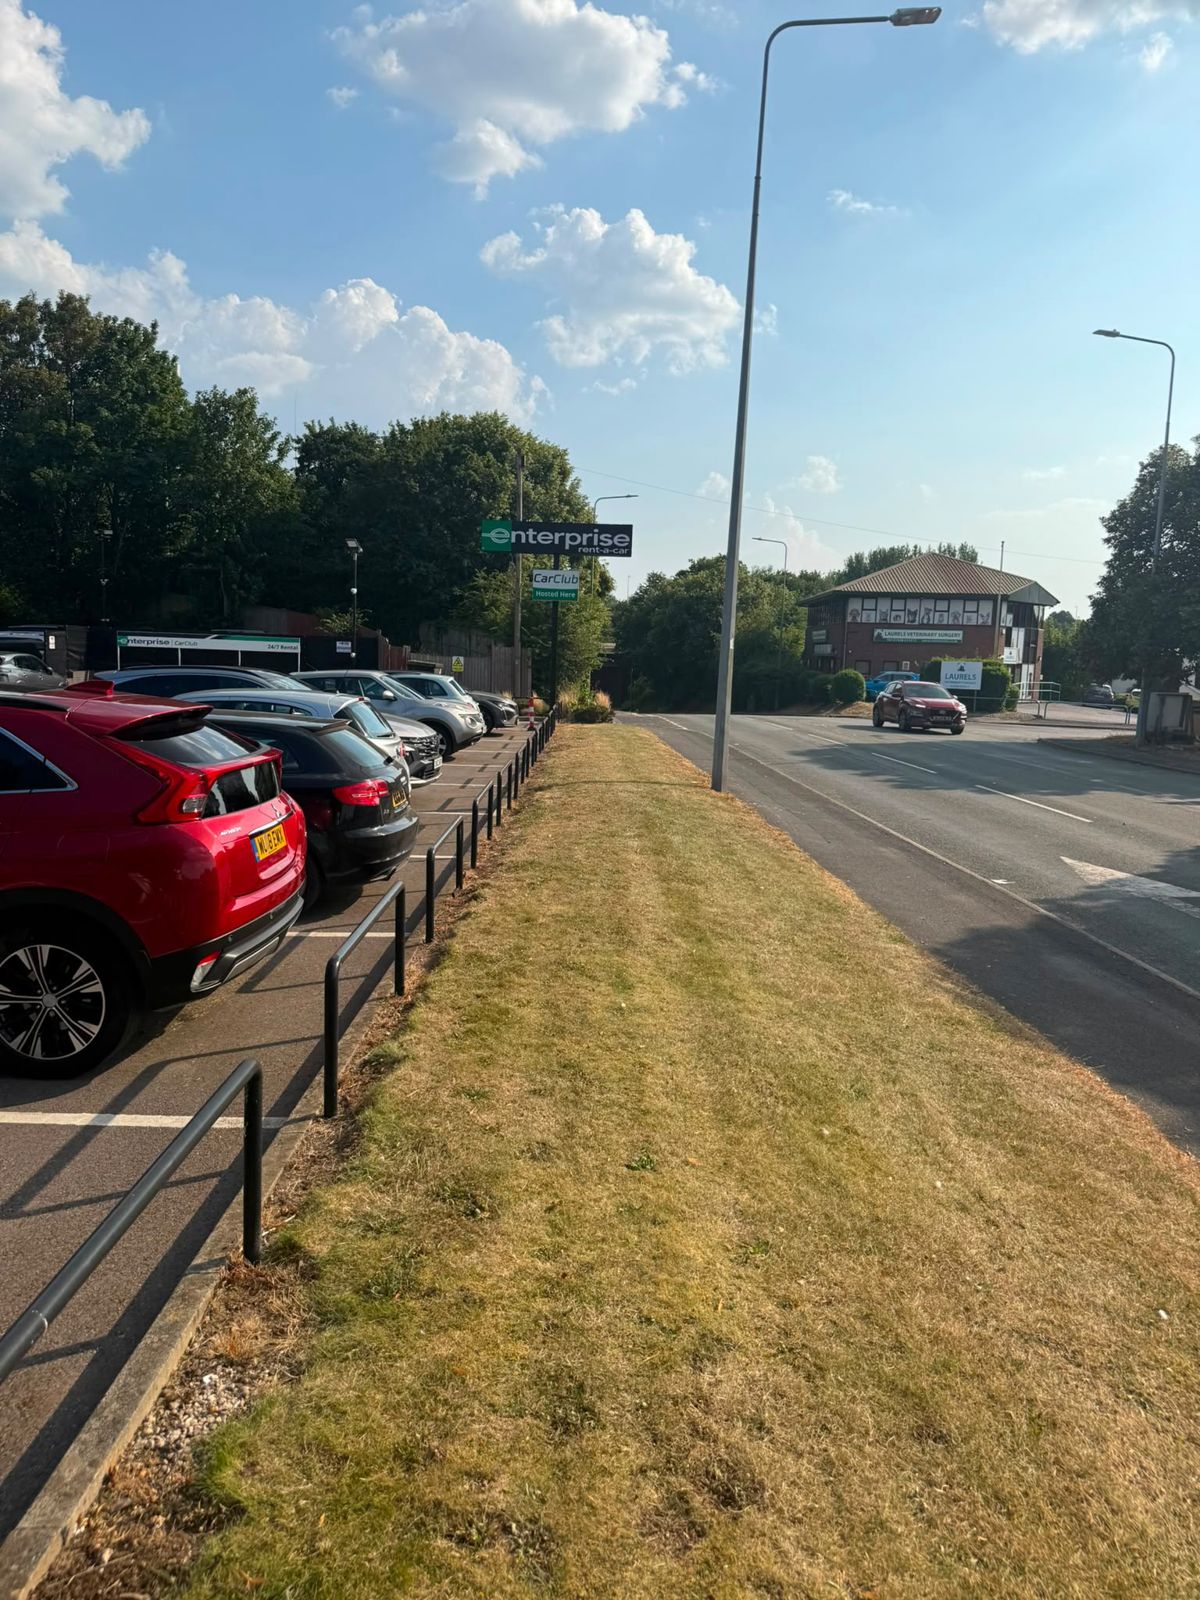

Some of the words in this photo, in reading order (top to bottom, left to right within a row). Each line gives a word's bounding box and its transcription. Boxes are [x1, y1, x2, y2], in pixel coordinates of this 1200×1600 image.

[488, 528, 630, 550] enterprise
[578, 546, 630, 555] rent-a-car
[533, 573, 579, 585] CarClub
[535, 590, 559, 598] Hosted
[560, 591, 576, 599] Here
[945, 672, 977, 681] LAURELS
